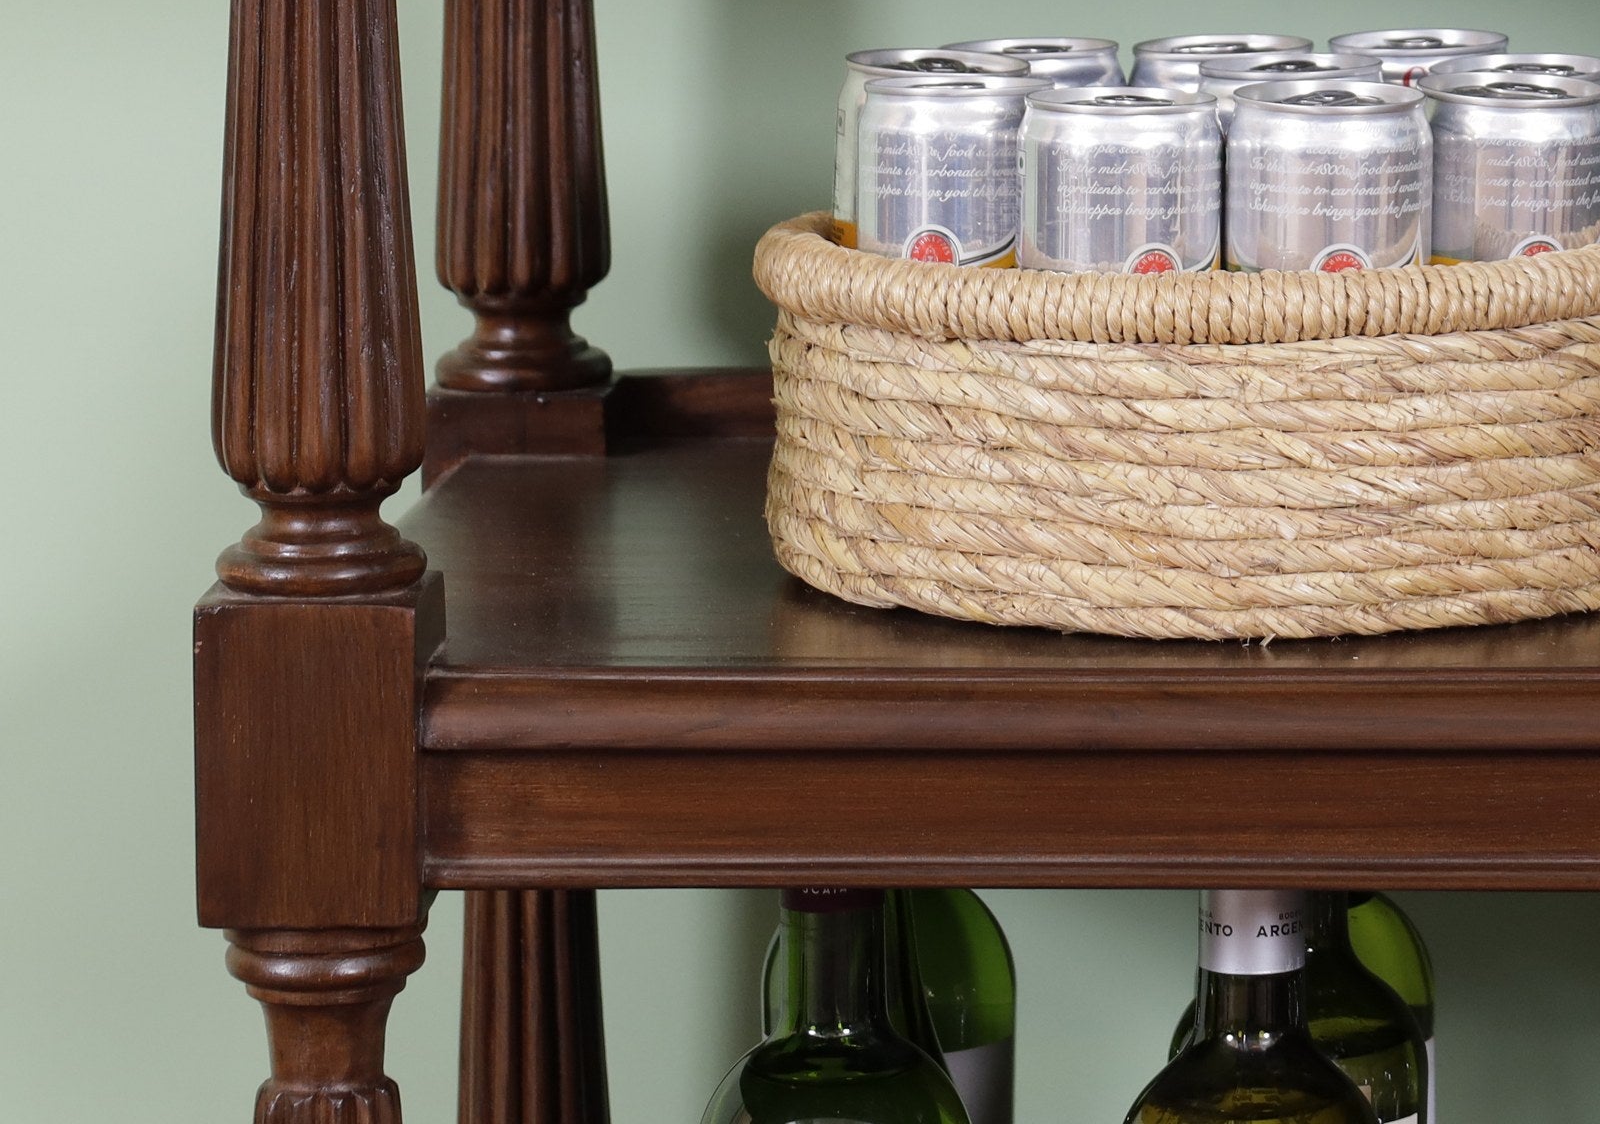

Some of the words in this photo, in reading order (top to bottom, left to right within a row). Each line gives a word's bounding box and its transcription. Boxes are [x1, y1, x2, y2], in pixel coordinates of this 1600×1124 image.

[922, 164, 990, 177] arbonated
[1249, 157, 1266, 170] In
[1352, 155, 1387, 179] food
[1486, 154, 1551, 169] mid-1800s,
[1249, 179, 1310, 195] ingredients
[1313, 184, 1328, 195] to
[1330, 179, 1399, 196] carbonated
[1512, 177, 1527, 188] to
[1529, 170, 1592, 187] carbonated
[940, 187, 971, 202] you
[1056, 180, 1124, 200] ingredients
[1125, 185, 1139, 195] to
[1056, 198, 1124, 219] Schweppes
[1125, 202, 1166, 220] brings
[1162, 204, 1188, 220] you
[1249, 197, 1310, 219] Schweppes
[1312, 202, 1355, 221] brings
[1352, 206, 1382, 221] you
[1381, 200, 1400, 215] the
[1510, 194, 1551, 212] brings
[1547, 198, 1575, 212] you
[1575, 191, 1591, 206] the
